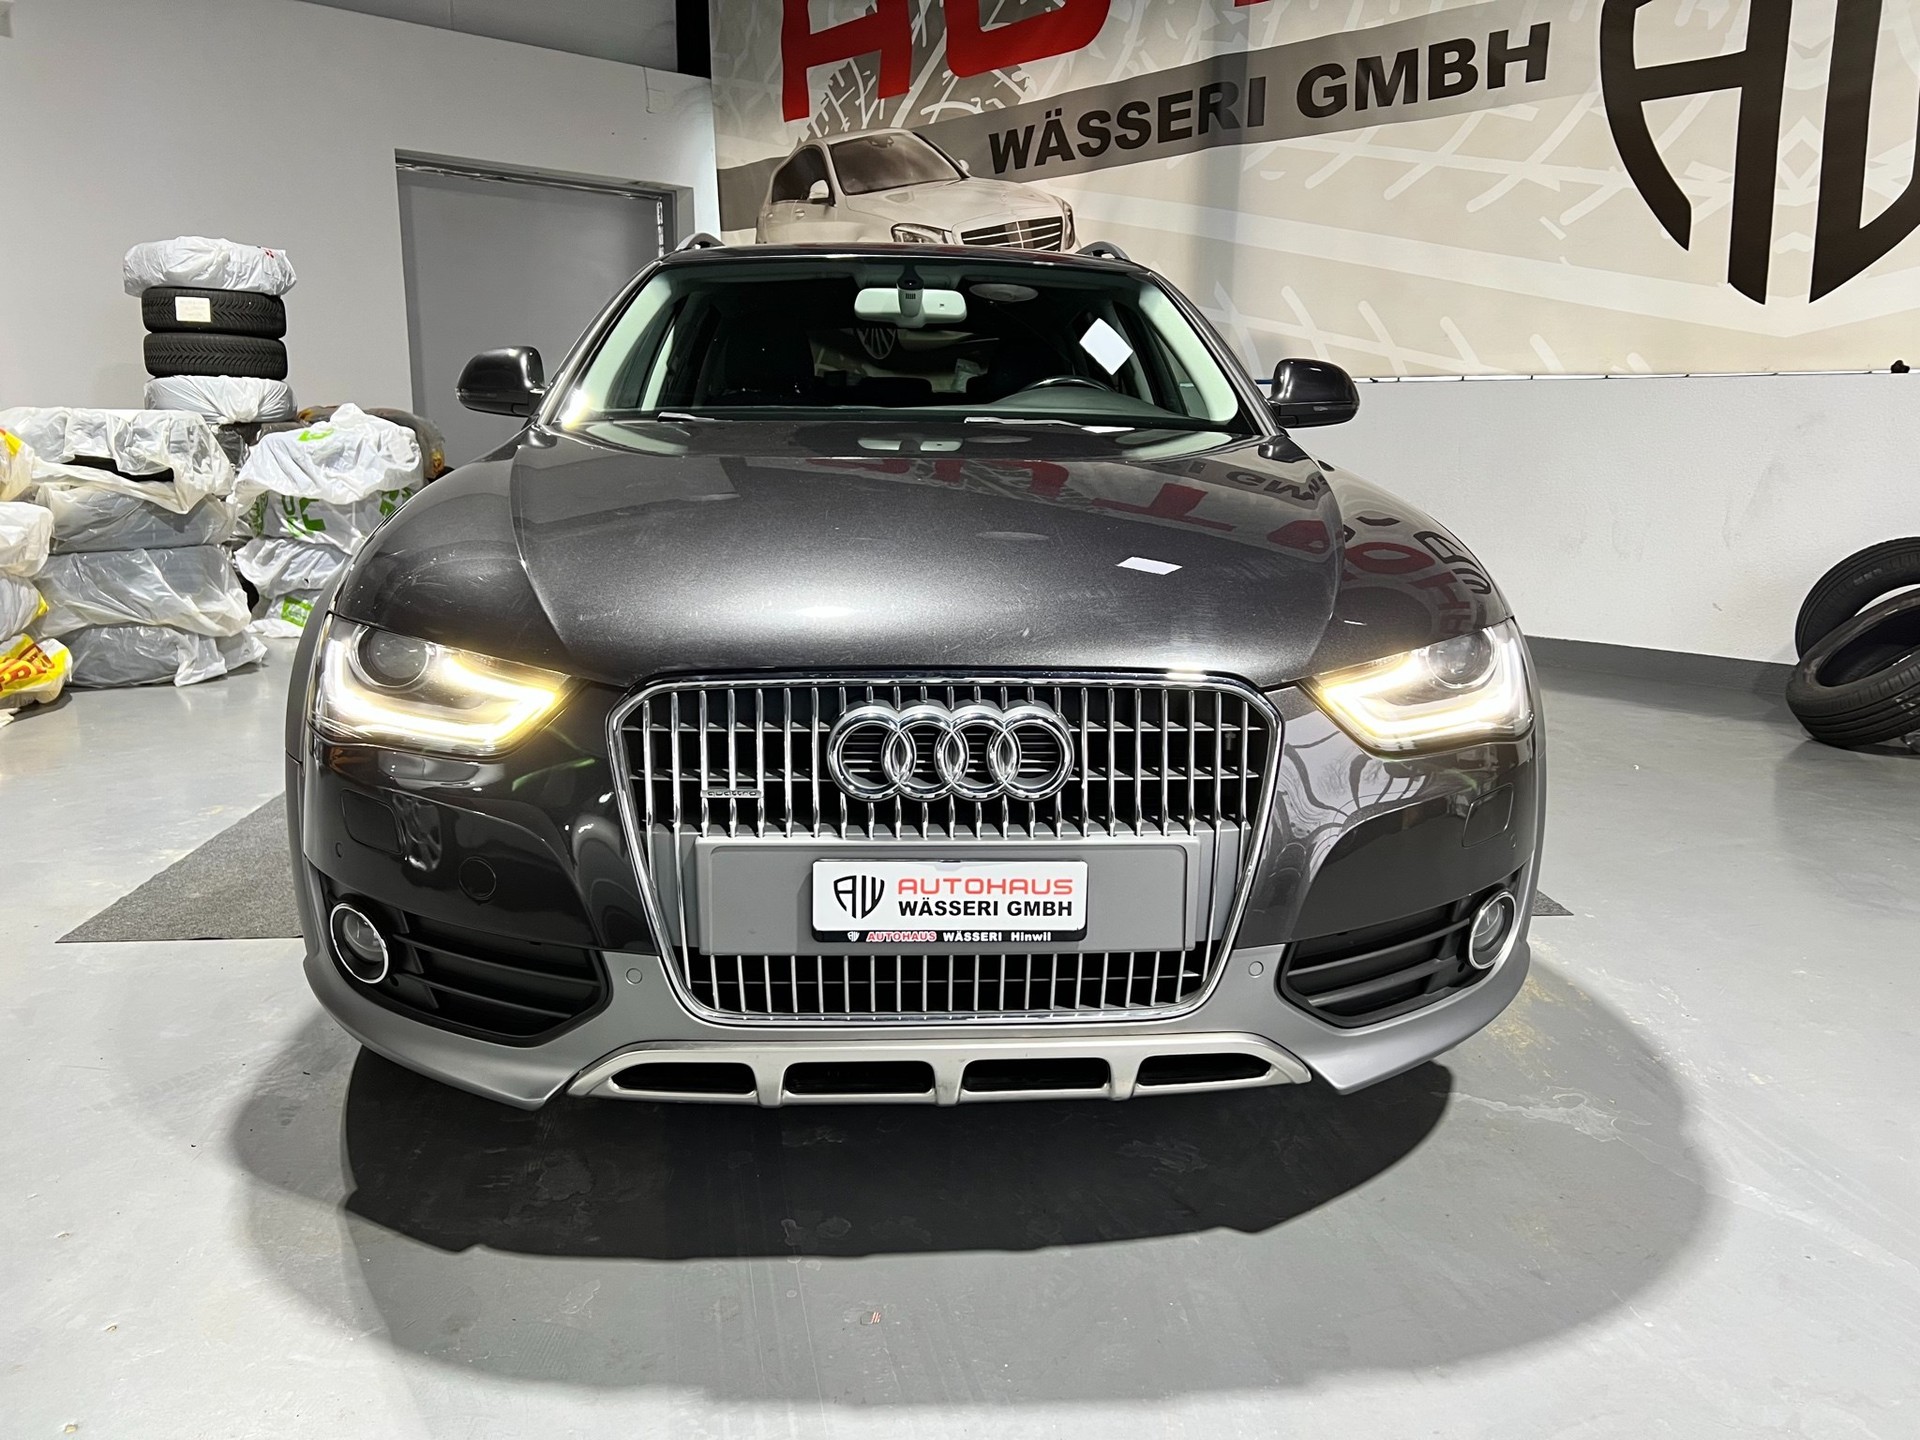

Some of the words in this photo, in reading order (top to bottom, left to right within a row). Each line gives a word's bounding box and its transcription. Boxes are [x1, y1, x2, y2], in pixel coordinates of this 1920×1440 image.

[988, 76, 1267, 175] WÄSSERI
[1297, 22, 1551, 119] GMBH
[898, 878, 1073, 895] AUTOHAUS
[898, 898, 999, 917] WÄSSERI
[1007, 900, 1073, 917] GMBH
[866, 931, 937, 942] AUTOHAUS
[943, 931, 1002, 942] WÄSSERI
[1010, 931, 1052, 942] Hinwil
